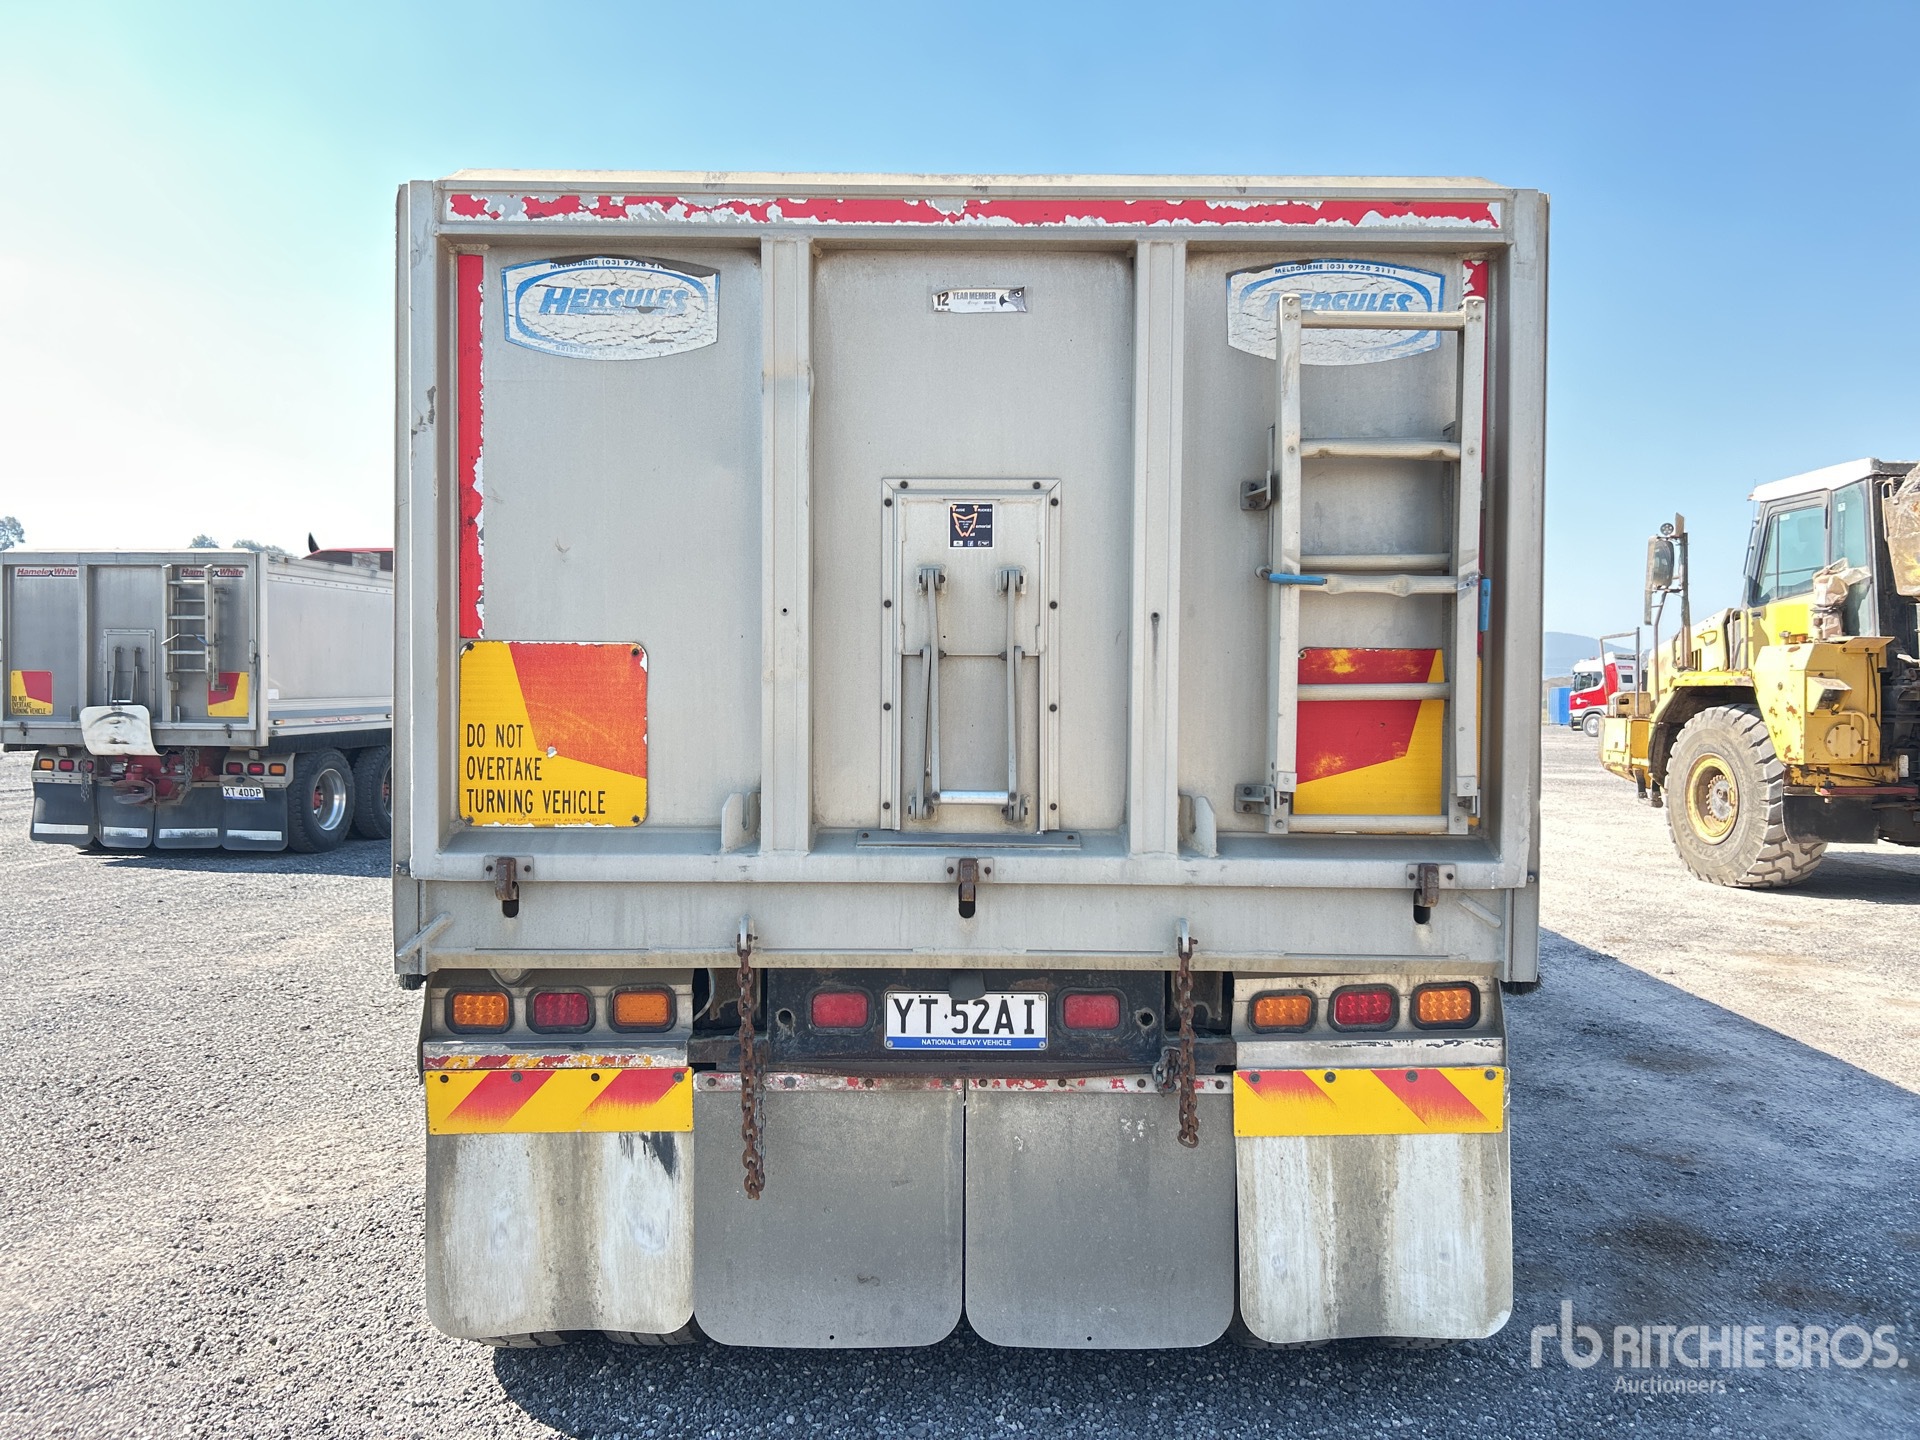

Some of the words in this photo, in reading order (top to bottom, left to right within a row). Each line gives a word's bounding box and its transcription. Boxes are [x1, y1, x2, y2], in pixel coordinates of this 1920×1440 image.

[1274, 263, 1323, 274] MELBOURNE
[1348, 264, 1371, 272] 9728
[1375, 266, 1397, 275] 2111
[538, 287, 690, 315] HERCULES
[937, 291, 949, 306] 12
[952, 291, 969, 300] YEAR
[969, 291, 997, 300] MEMBER
[466, 723, 486, 748] DO
[495, 723, 524, 749] NOT
[466, 756, 542, 781] OVERTAKE
[224, 787, 236, 797] XT
[238, 788, 262, 797] 40DP
[466, 788, 534, 814] TURNING
[542, 789, 606, 815] VEHICLE
[982, 1039, 1012, 1047] VEHICLE
